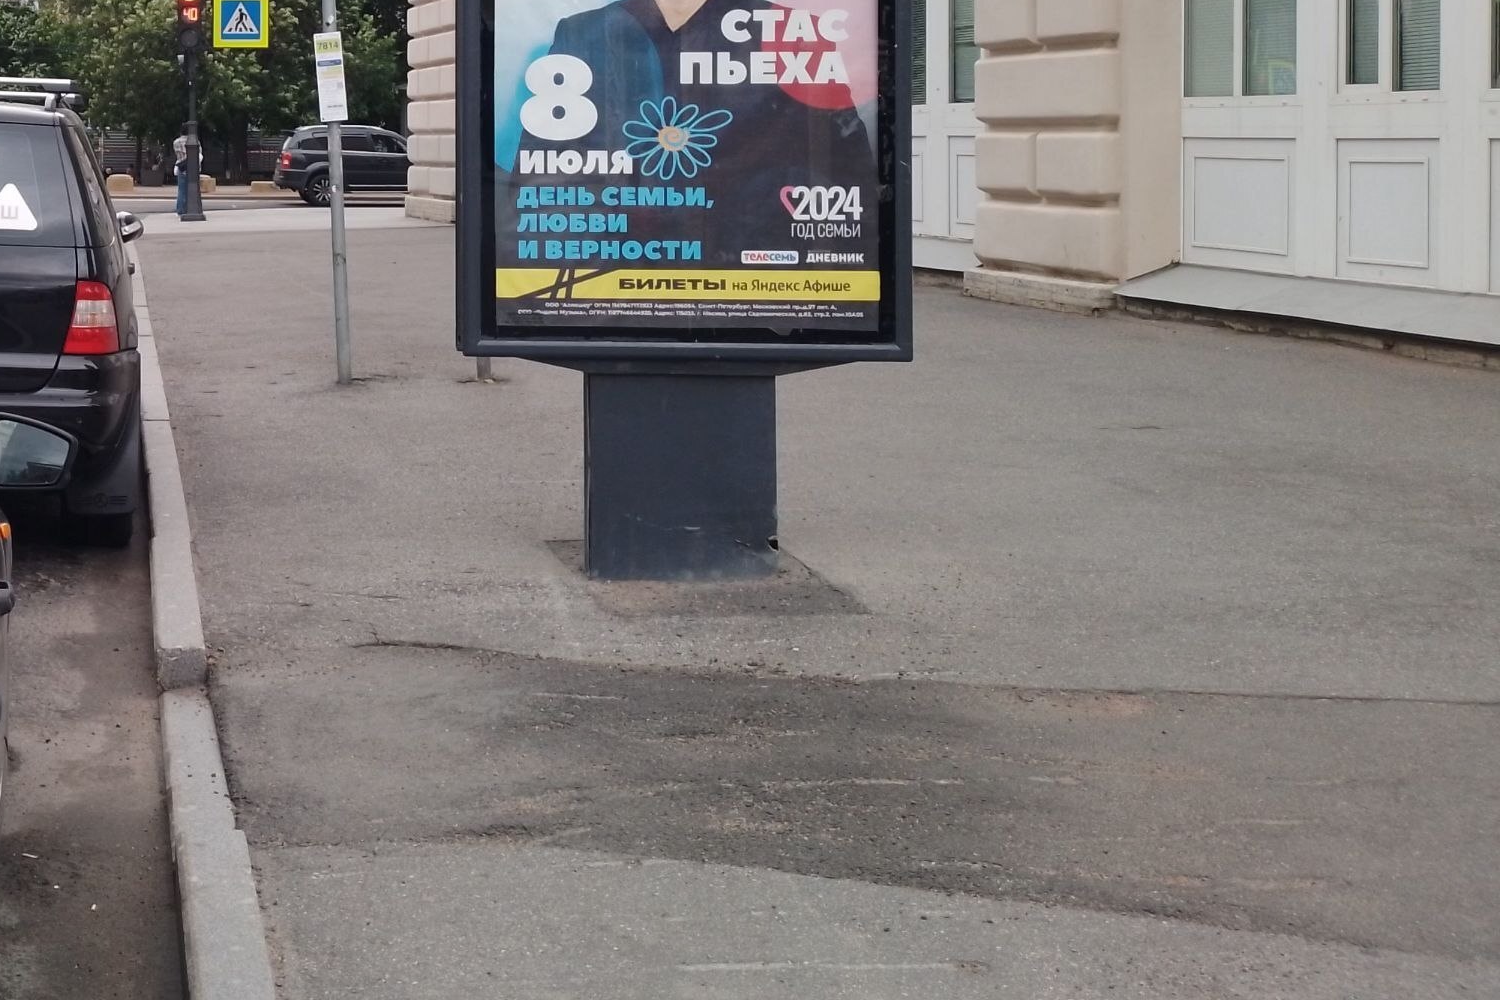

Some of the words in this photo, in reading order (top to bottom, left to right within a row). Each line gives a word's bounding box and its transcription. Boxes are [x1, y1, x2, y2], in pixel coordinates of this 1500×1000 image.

[721, 9, 849, 43] СТАС
[680, 52, 849, 85] ПЬЕХА
[520, 54, 598, 141] 8
[520, 150, 633, 174] ИЮЛЯ
[517, 187, 594, 208] ДЕНЬ
[602, 187, 714, 208] СЕМЬИ,
[792, 186, 863, 220] 2024
[517, 214, 627, 232] ЛЮБВИ
[518, 240, 538, 259] И
[545, 240, 701, 260] ВЕРНОСТИ
[806, 252, 865, 263] ДНЕВНИК
[619, 278, 726, 290] БИЛЕТЫ
[732, 281, 748, 291] на
[751, 279, 800, 292] Яндекс
[803, 280, 850, 292] Афише
